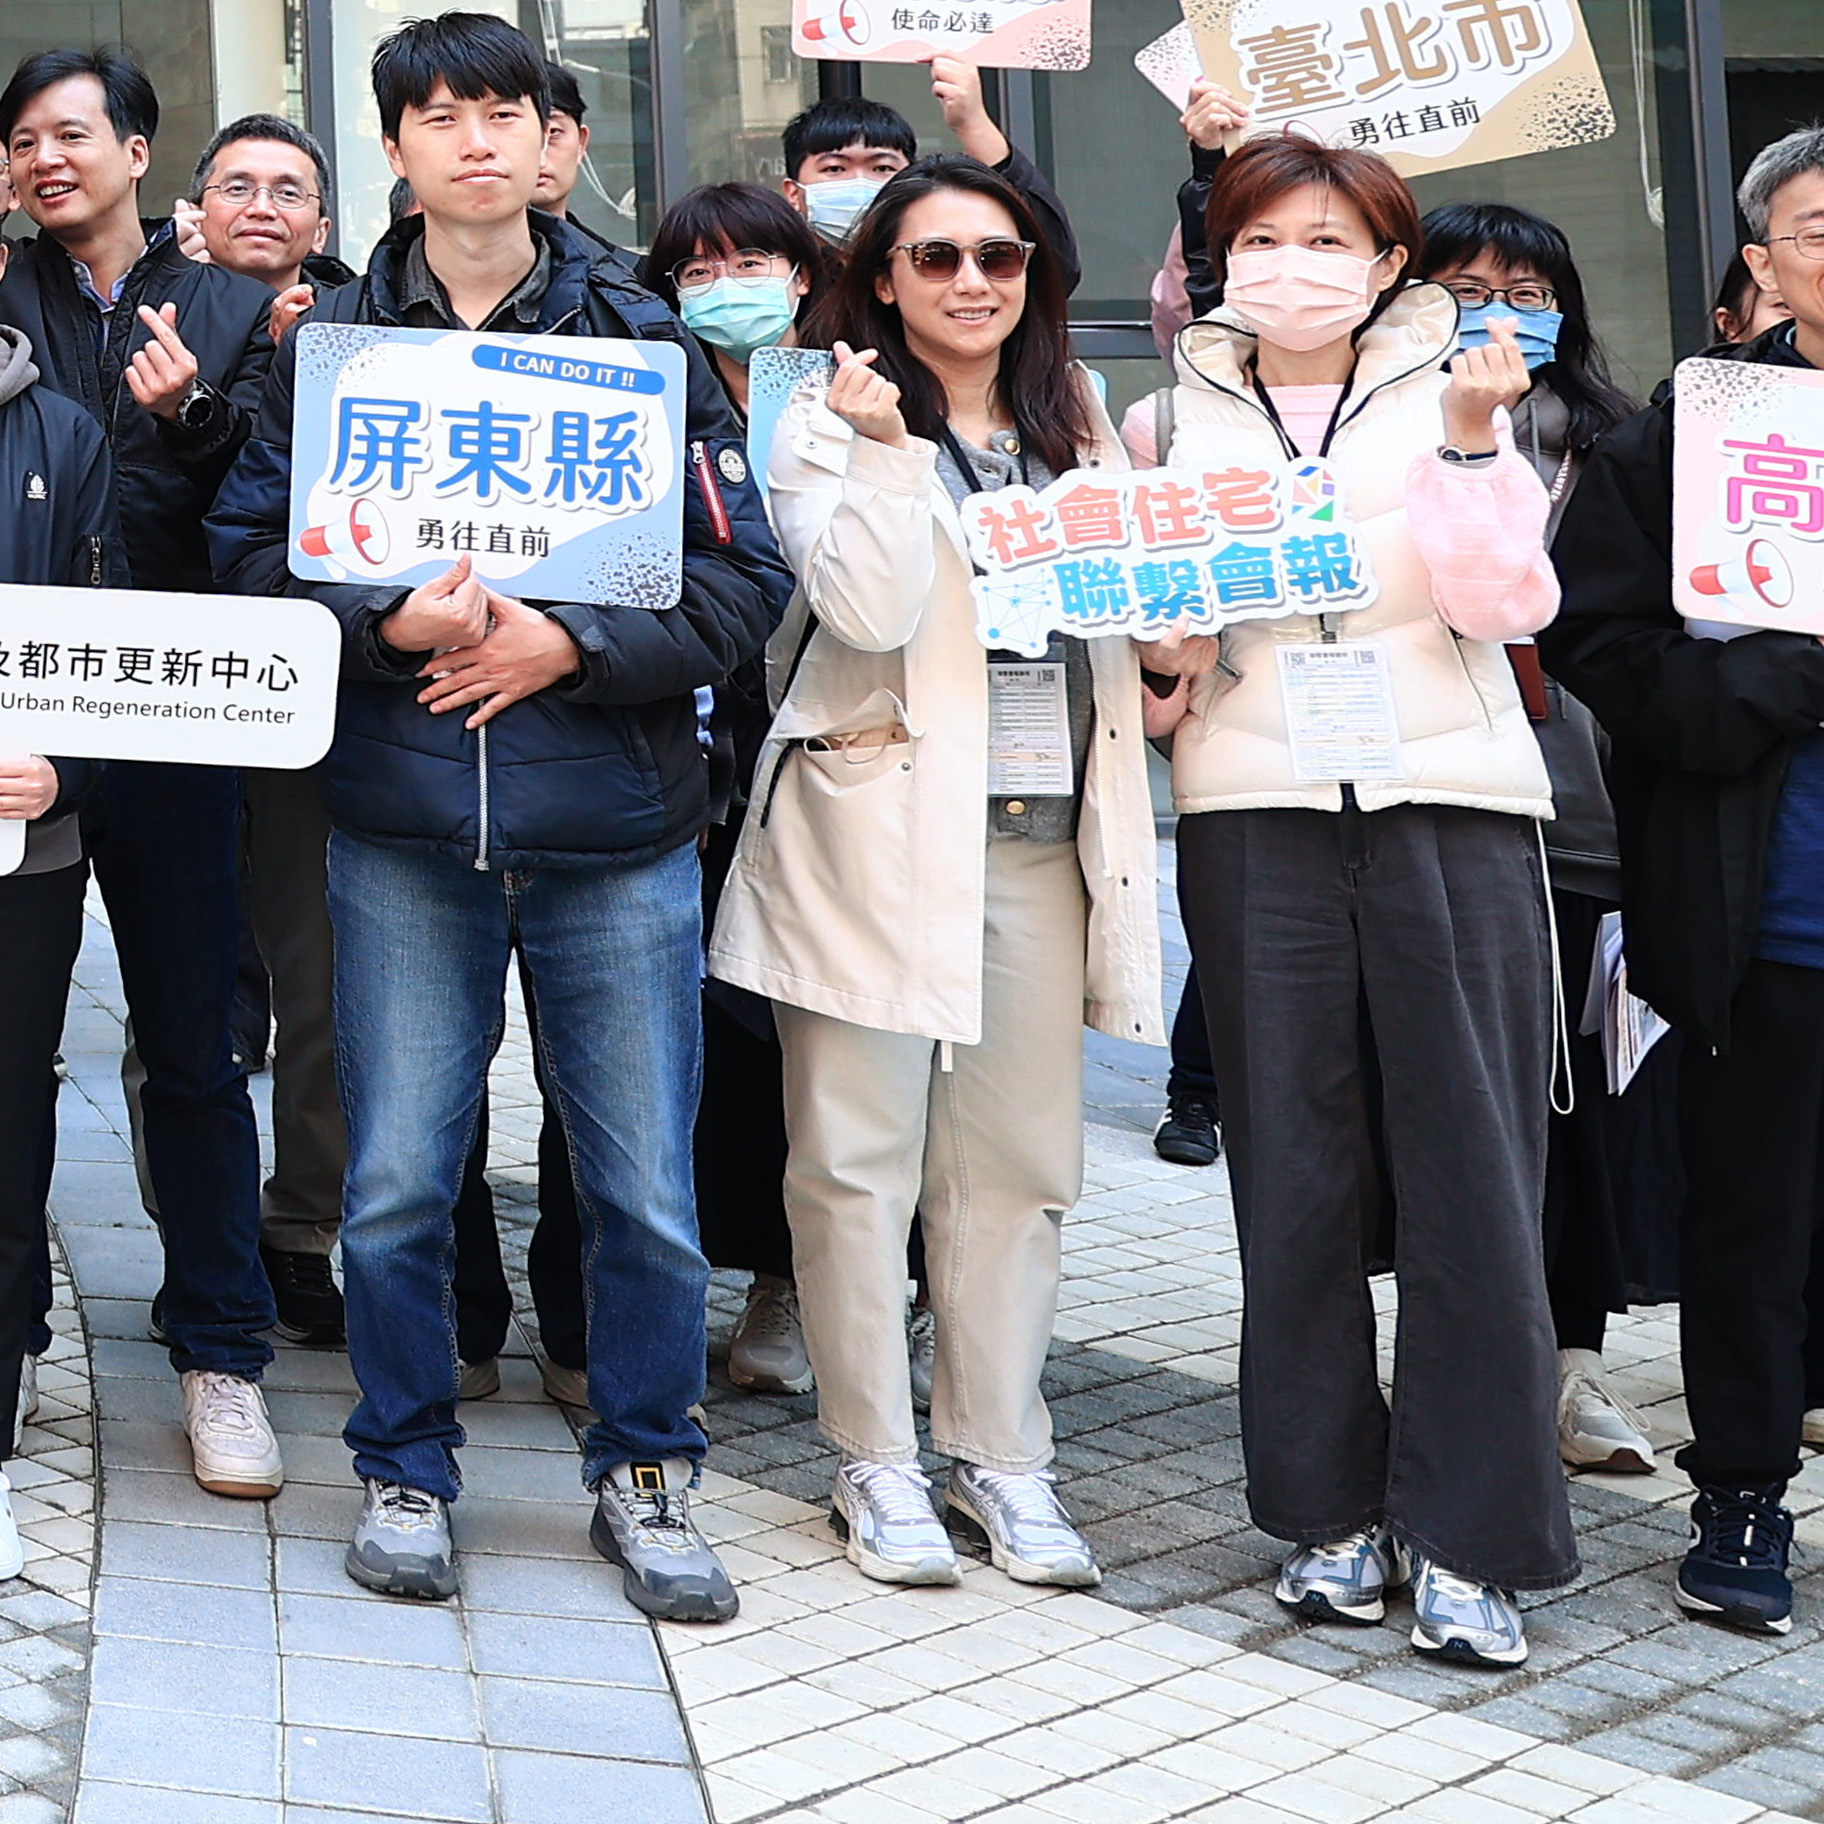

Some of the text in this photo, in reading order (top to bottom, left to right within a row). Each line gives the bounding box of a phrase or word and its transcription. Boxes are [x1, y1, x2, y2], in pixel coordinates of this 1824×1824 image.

[891, 8, 994, 34] 使命必達
[1348, 96, 1481, 149] 勇往直前
[501, 352, 635, 387] I CAN DO IT !!
[331, 396, 643, 506] 屏東縣
[416, 518, 551, 557] 勇往直前
[979, 468, 1278, 562] 社會住宅
[1053, 533, 1359, 621] 聯繫會報
[0, 691, 65, 712] Urban
[72, 695, 216, 721] Regeneration
[223, 704, 295, 725] Center
